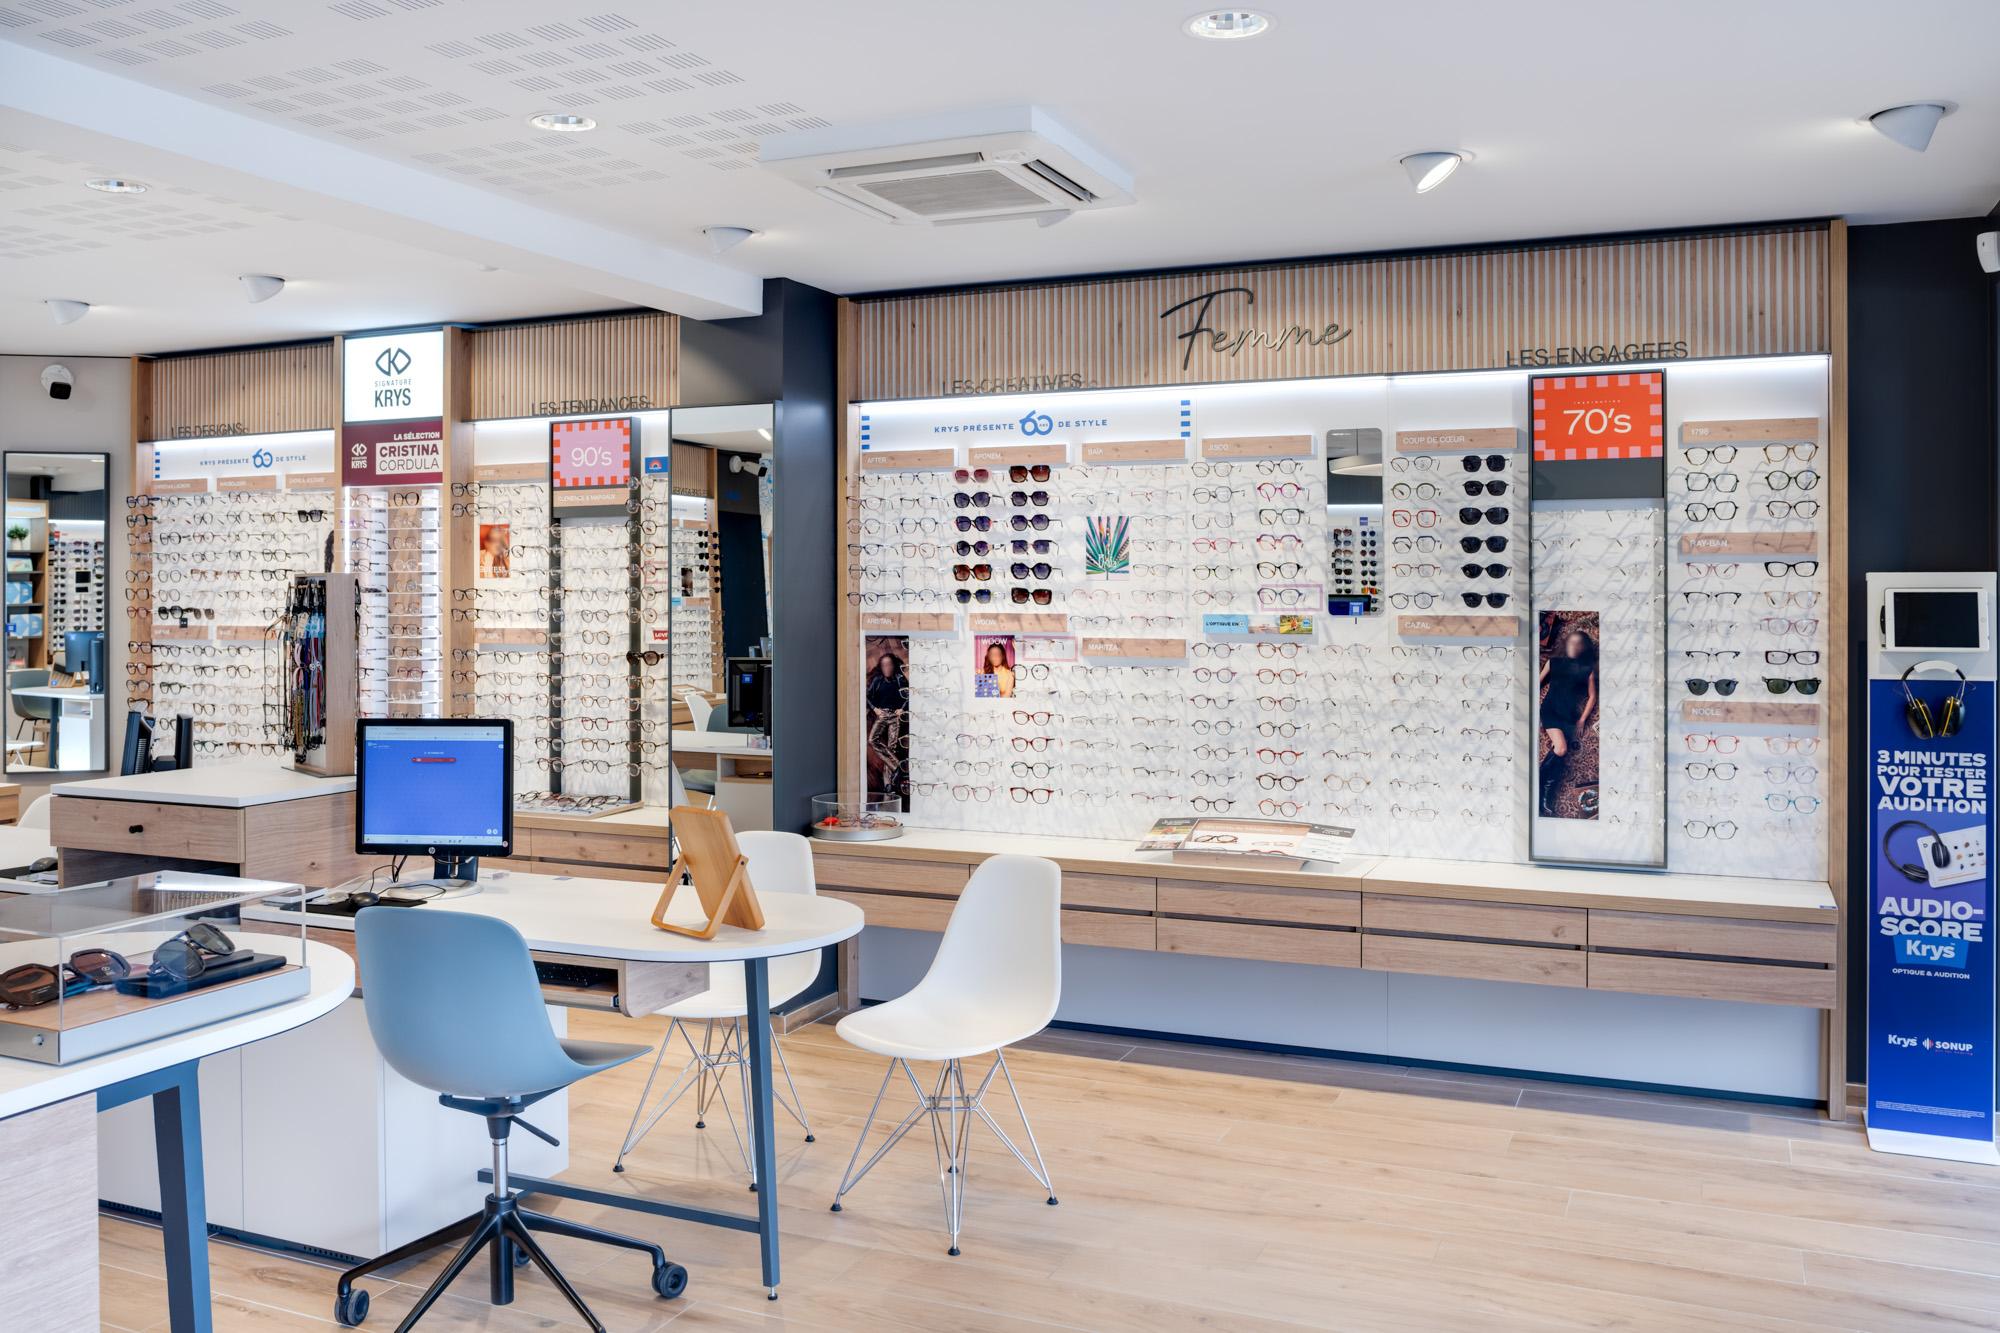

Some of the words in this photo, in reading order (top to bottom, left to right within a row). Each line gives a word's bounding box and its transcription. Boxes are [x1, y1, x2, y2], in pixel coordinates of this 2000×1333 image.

[1160, 287, 1352, 370] Femme
[1506, 348, 1548, 367] LES
[374, 378, 412, 387] SIGNATURE
[942, 380, 974, 396] LES
[374, 387, 412, 408] KRYS
[531, 401, 557, 416] LES
[560, 395, 649, 414] TENDANCES
[934, 425, 960, 433] KRYS
[962, 422, 1015, 432] PRÉSENTE
[1058, 420, 1071, 428] DE
[1074, 419, 1108, 427] STYLE
[1563, 407, 1632, 436] 70's
[171, 425, 191, 439] LES
[393, 433, 403, 441] LA
[403, 431, 440, 441] SÉLECTION
[1402, 436, 1425, 445] COUP
[1427, 436, 1437, 444] DE
[379, 443, 439, 458] CRISTINA
[571, 445, 613, 467] 90's
[351, 460, 368, 469] KRYS
[379, 458, 439, 471] CORDULA
[1690, 539, 1728, 547] RAY-BAN
[1404, 621, 1431, 629] CAZAL
[1877, 749, 1891, 764] 3
[1893, 750, 1987, 767] MINUTES
[1877, 765, 1920, 777] POUR
[1923, 766, 1986, 779] TESTER
[1877, 775, 1987, 799] VOTRE
[1877, 796, 1987, 815] AUDITION
[1879, 896, 1984, 921] AUDIO-
[1880, 916, 1983, 942] SCORE
[1906, 939, 1956, 961] Krys
[1892, 967, 1925, 976] OPTIQUE
[1934, 971, 1970, 979] AUDITION
[1888, 1034, 1918, 1048] Krys
[1935, 1041, 1973, 1052] SONUP
